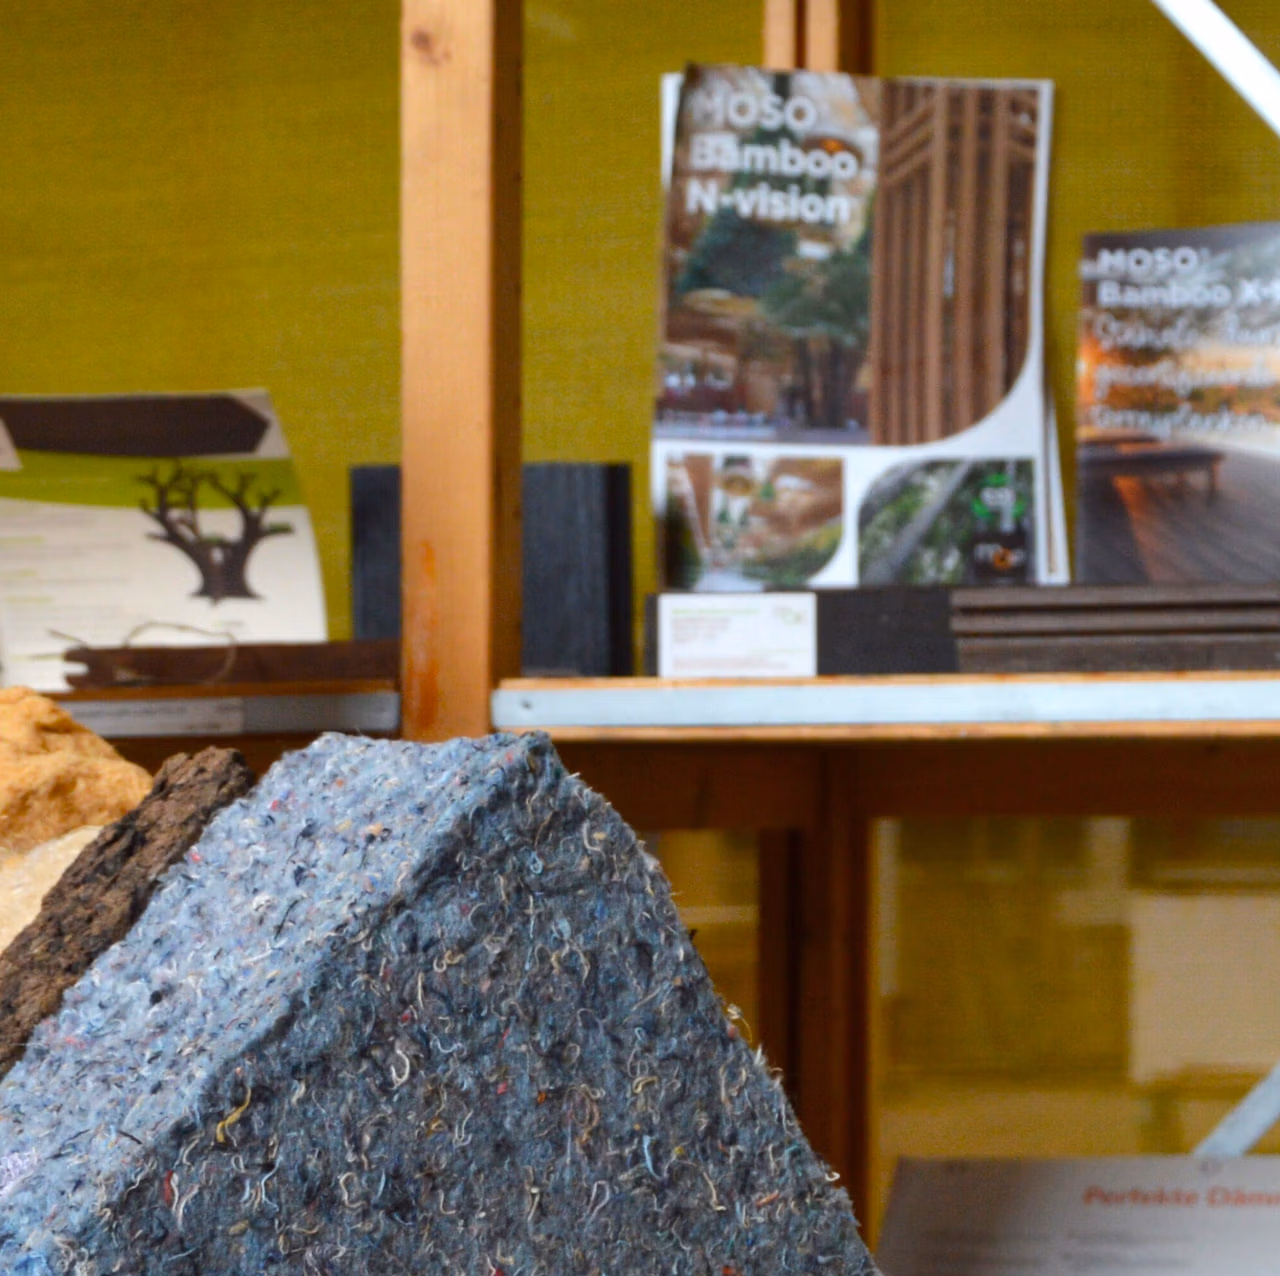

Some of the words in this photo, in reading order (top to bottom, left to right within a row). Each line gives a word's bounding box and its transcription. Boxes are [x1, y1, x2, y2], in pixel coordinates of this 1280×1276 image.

[689, 132, 859, 178] Bamboo
[686, 178, 851, 226] N-vision
[1097, 279, 1233, 308] Bamboo
